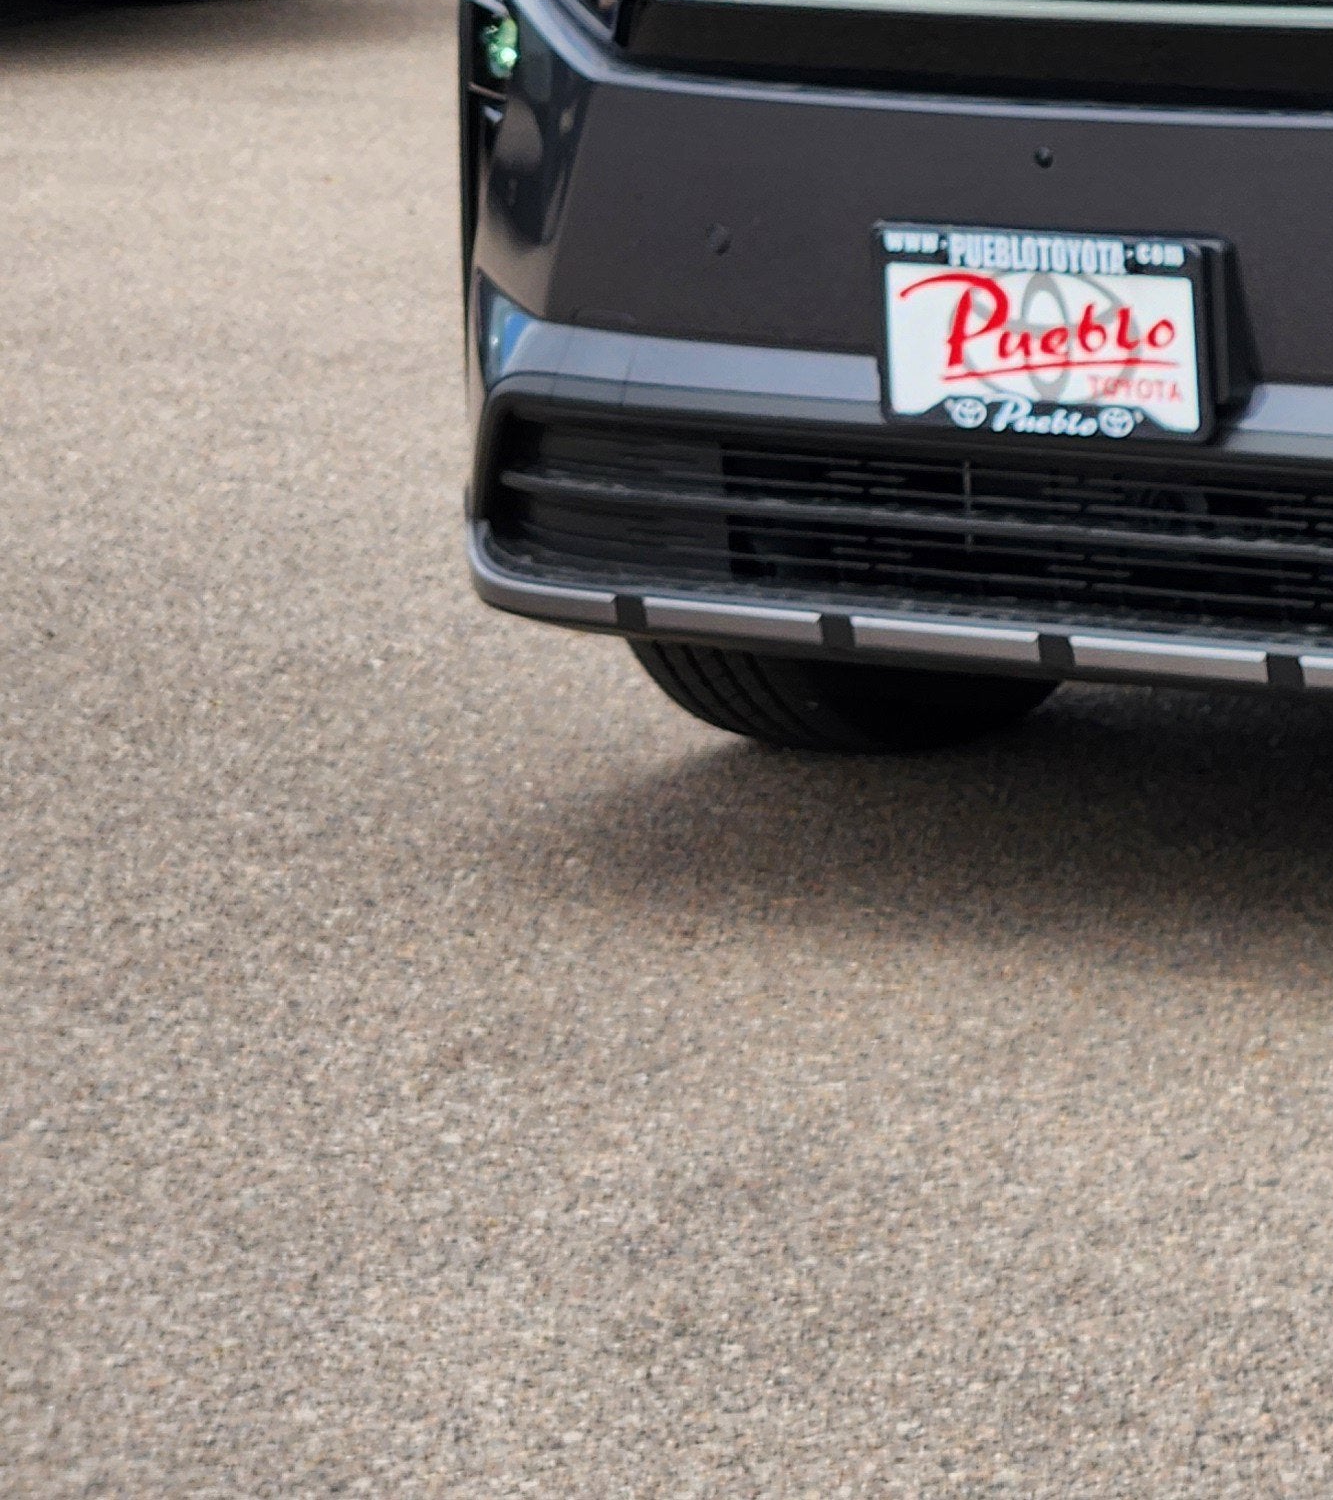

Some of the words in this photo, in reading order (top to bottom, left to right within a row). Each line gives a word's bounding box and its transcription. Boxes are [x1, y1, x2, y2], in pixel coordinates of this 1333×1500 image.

[900, 273, 1176, 367] Pueblo
[1088, 374, 1182, 402] TOYOTA
[990, 399, 1099, 437] Pueblo
